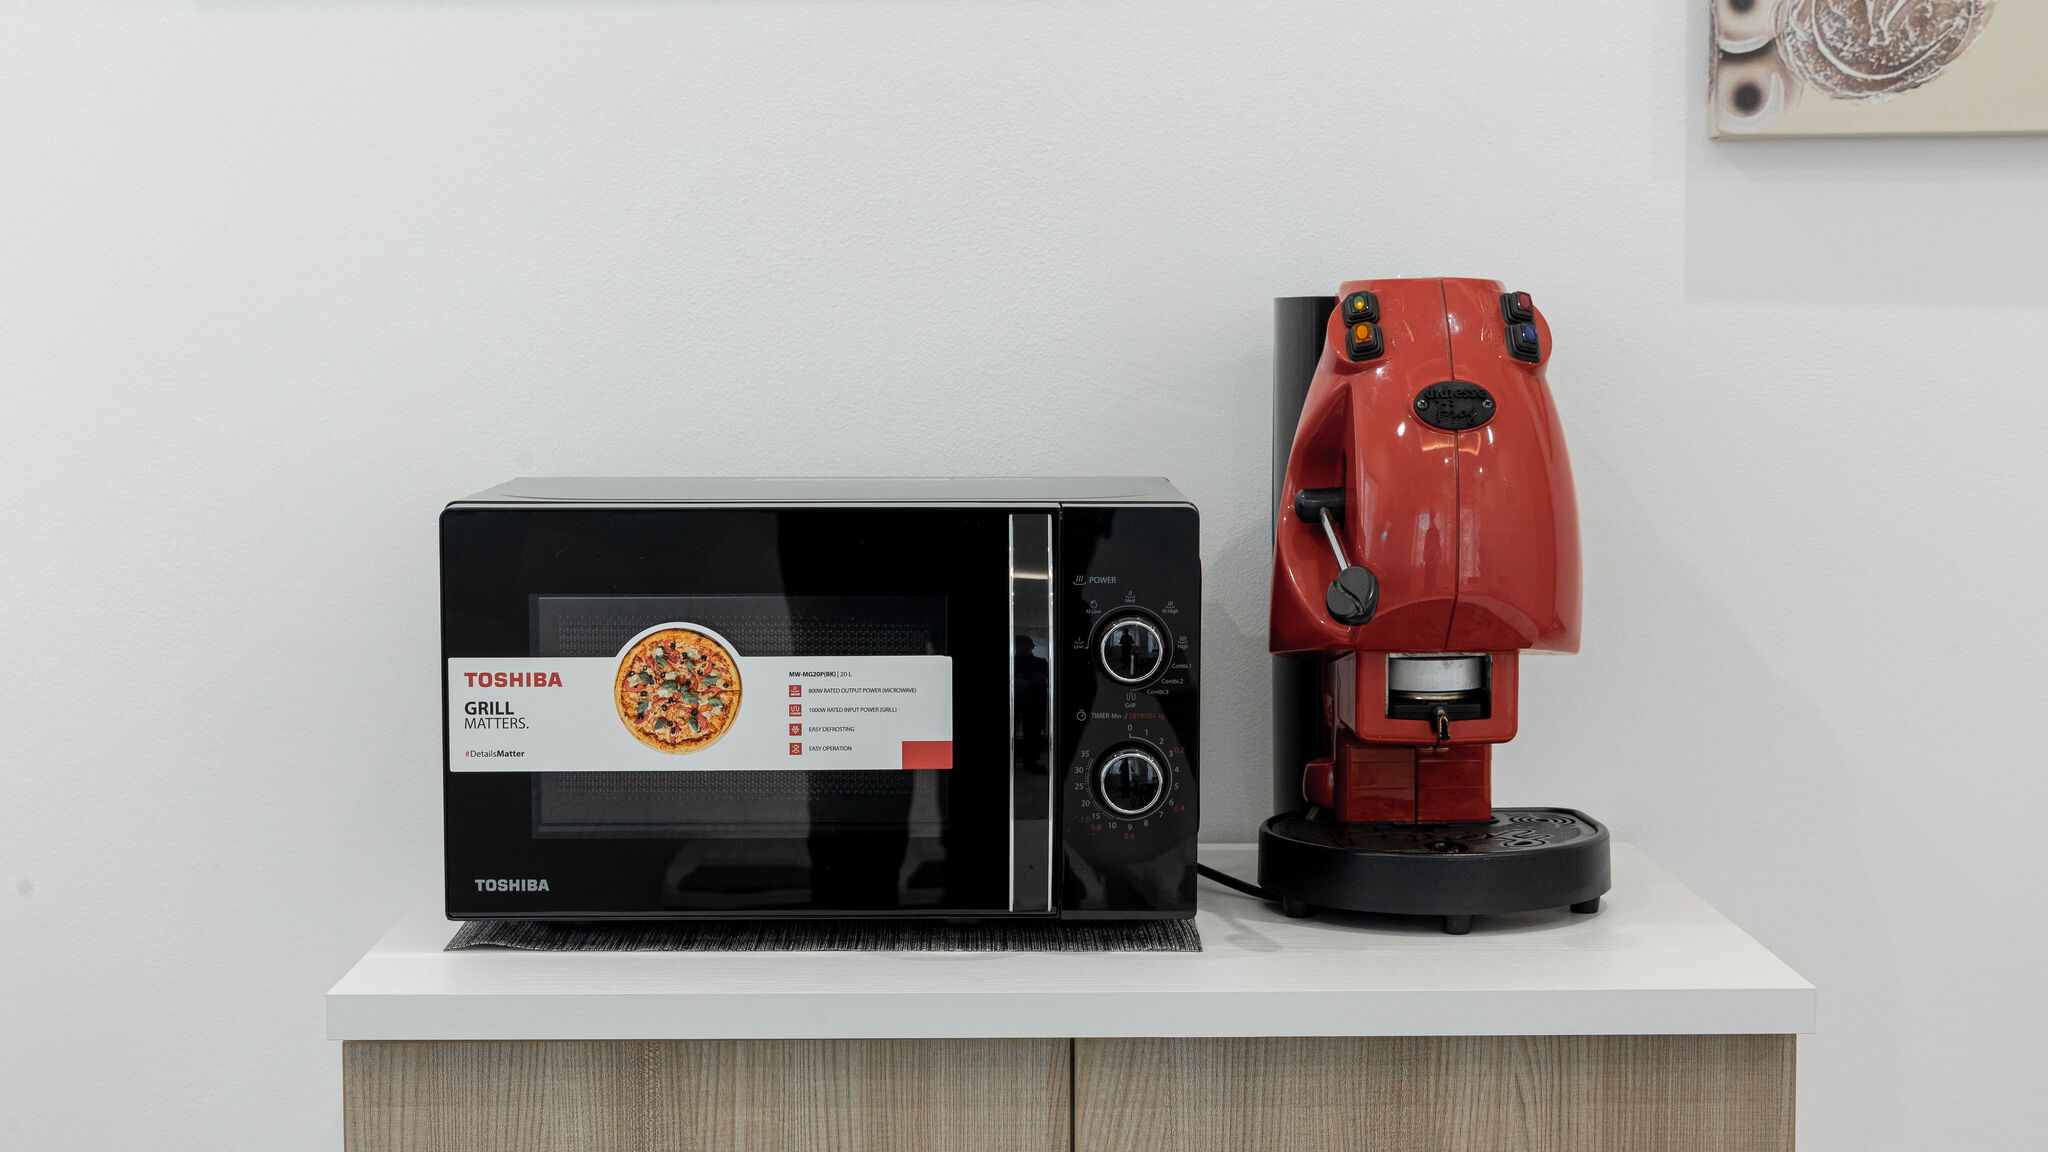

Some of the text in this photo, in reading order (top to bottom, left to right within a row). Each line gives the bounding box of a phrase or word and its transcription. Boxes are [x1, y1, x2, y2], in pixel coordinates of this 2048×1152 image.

[1089, 576, 1117, 584] POWER
[464, 672, 562, 688] TOSHIBA
[464, 701, 514, 715] GRILL
[464, 717, 530, 729] MATTERS.
[465, 750, 525, 758] #DetailsMatter
[475, 879, 550, 892] TOSHIBA
